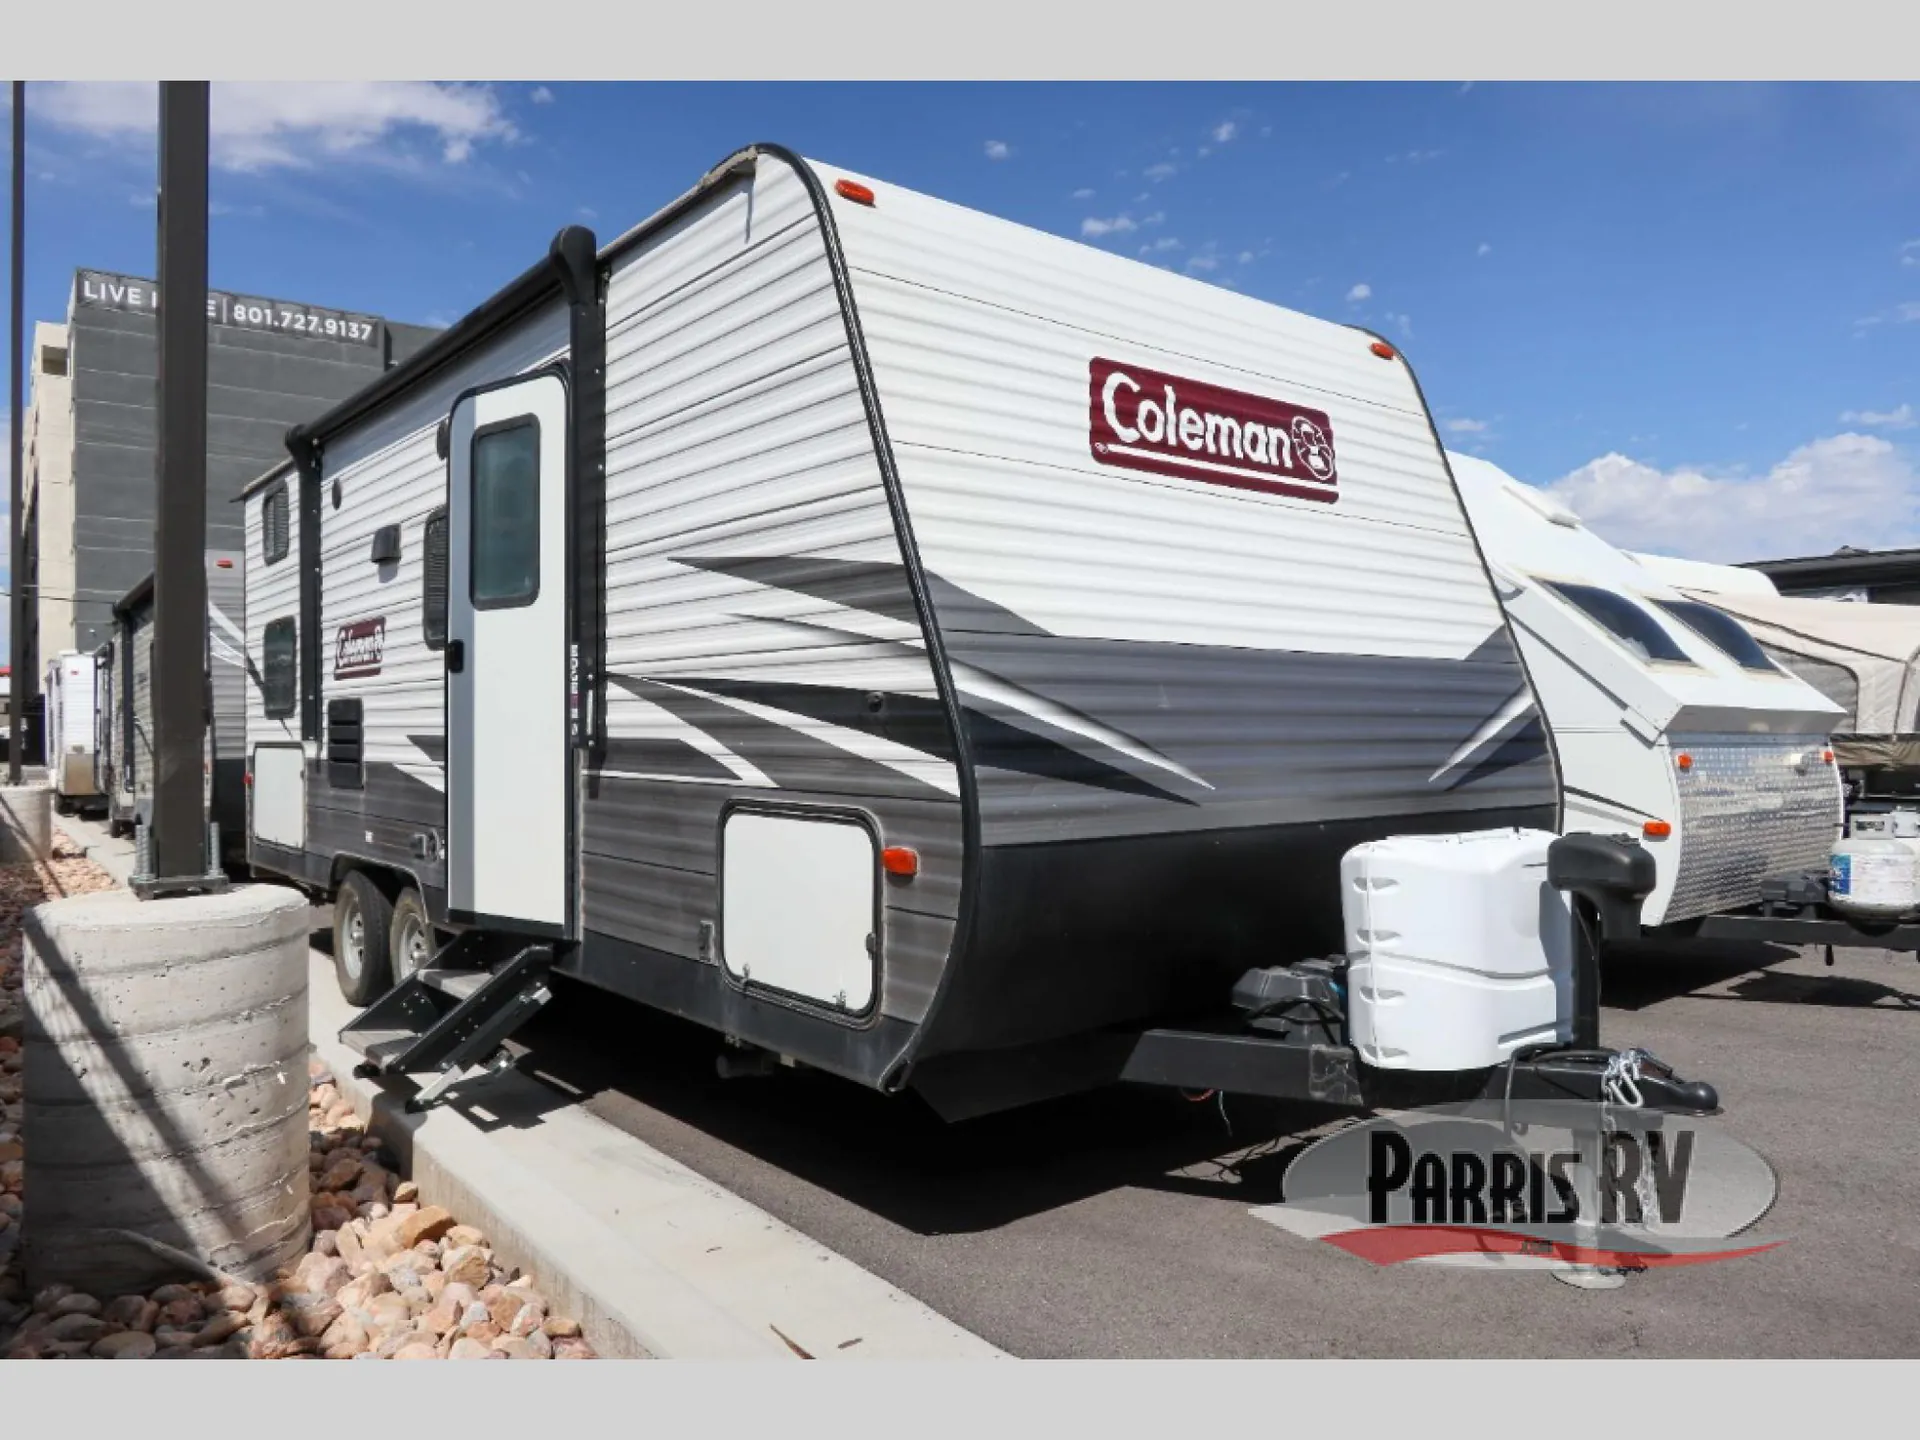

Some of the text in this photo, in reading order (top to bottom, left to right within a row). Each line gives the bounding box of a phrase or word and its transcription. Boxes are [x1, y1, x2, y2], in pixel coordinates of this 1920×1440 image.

[83, 280, 142, 305] LIVE
[233, 303, 372, 340] 801.727.9137
[1102, 371, 1293, 469] Coleman
